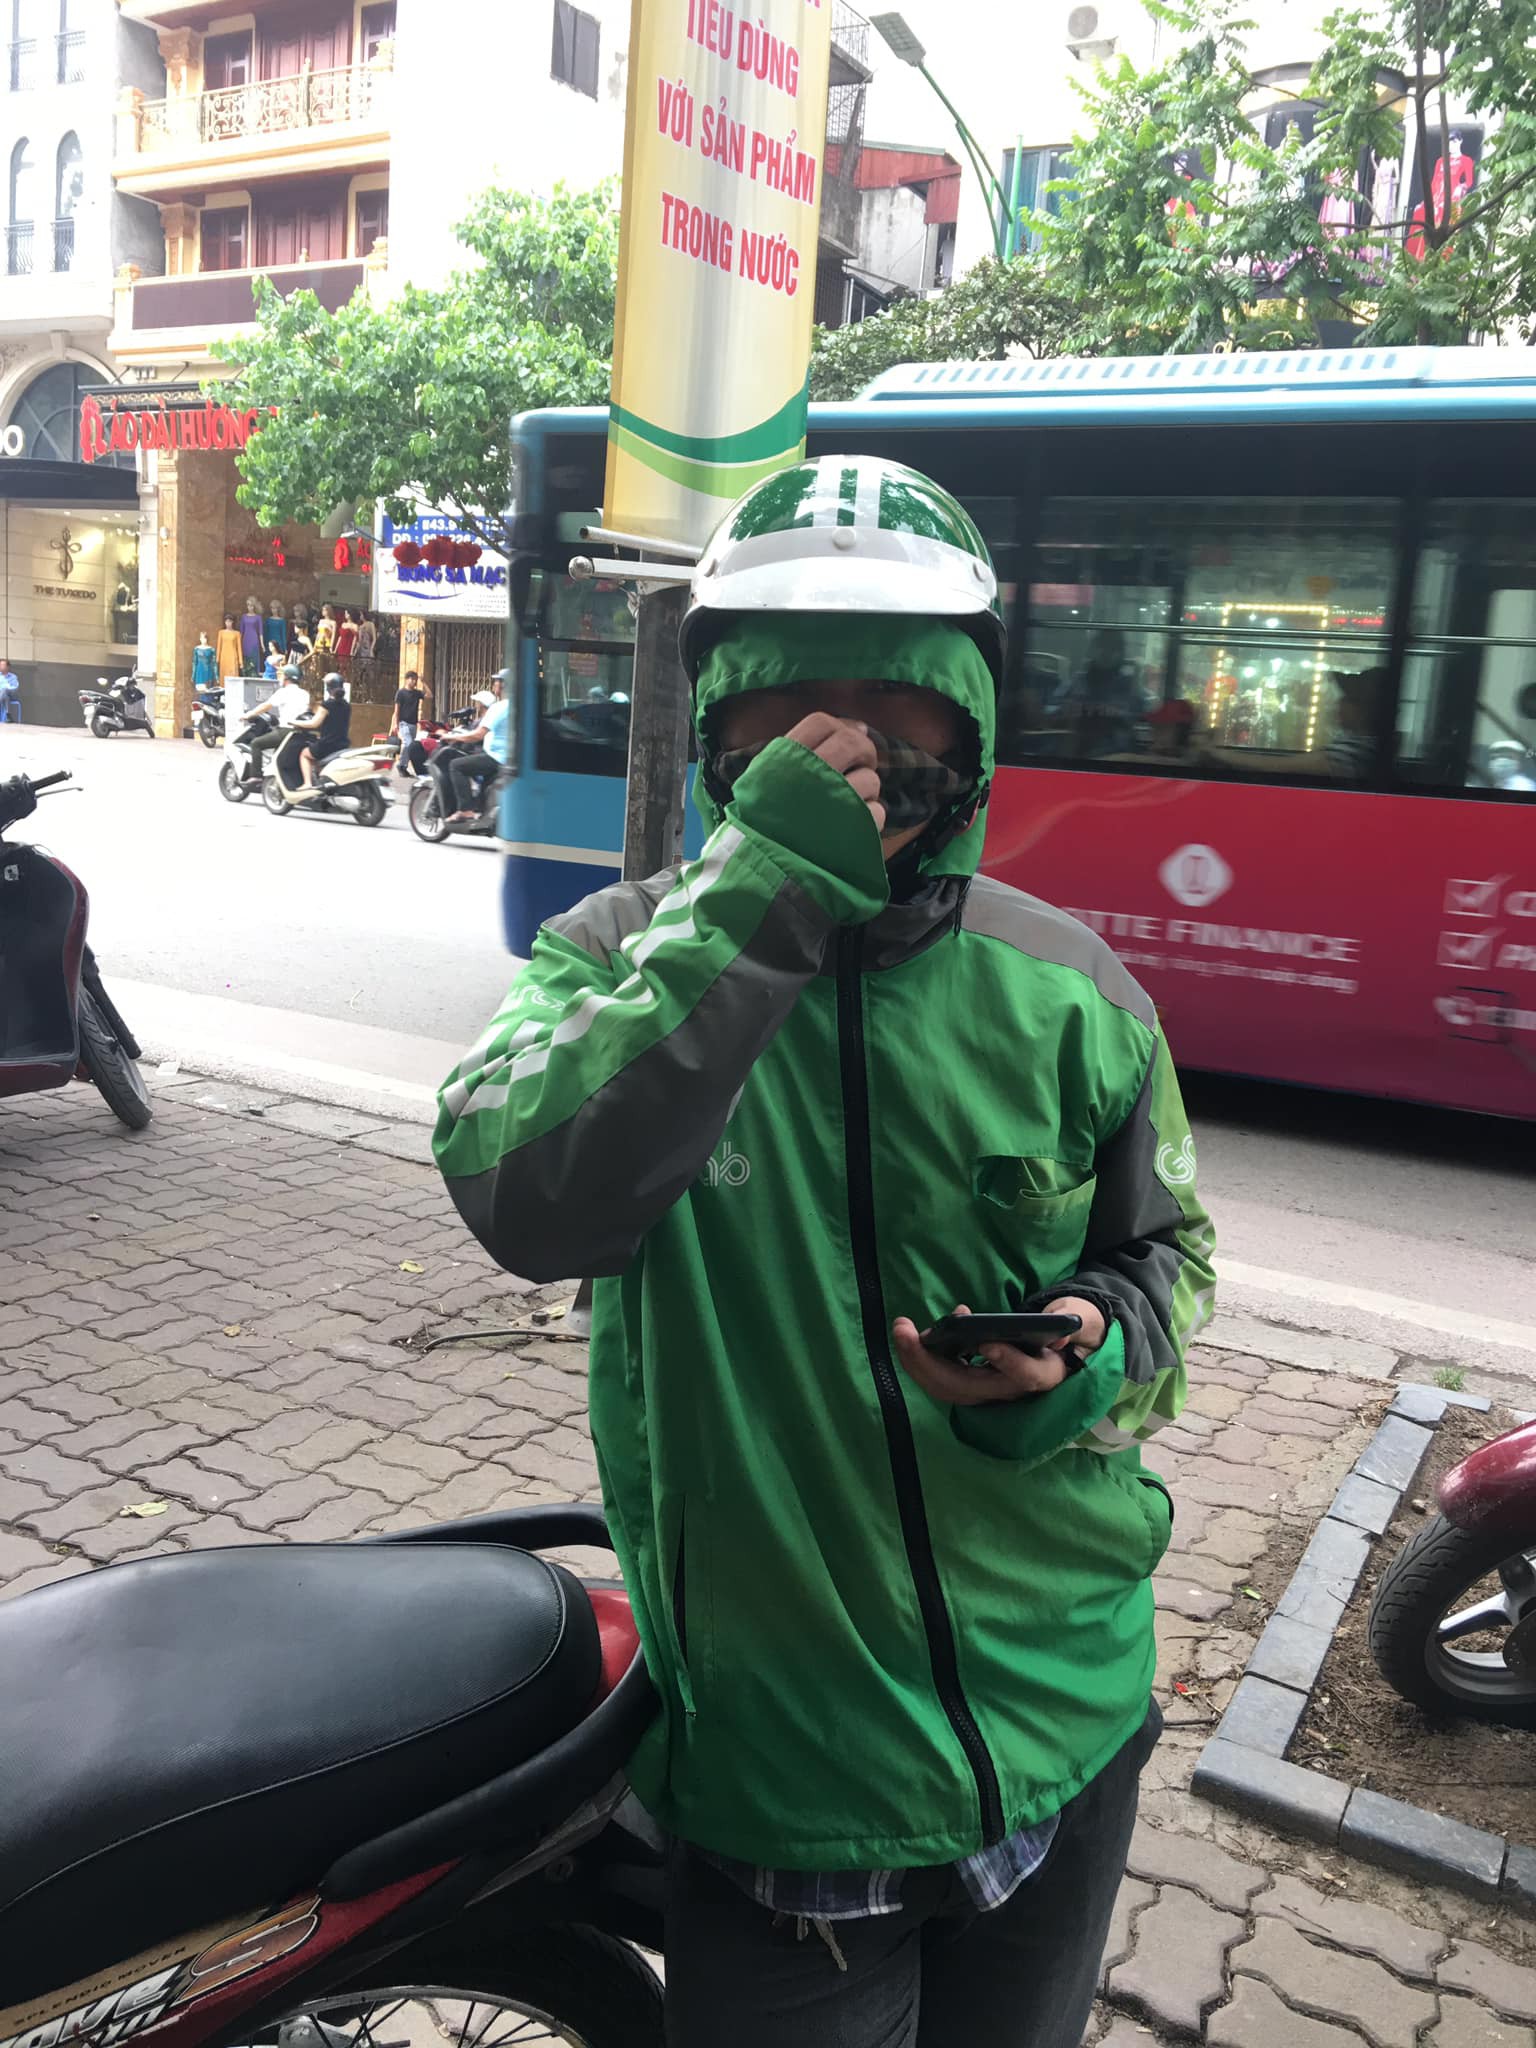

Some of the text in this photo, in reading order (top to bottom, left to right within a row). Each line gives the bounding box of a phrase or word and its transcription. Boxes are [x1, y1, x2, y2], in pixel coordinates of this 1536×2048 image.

[737, 19, 800, 97] DÙNG
[658, 78, 816, 205] VỚI SẢN PHẨM
[662, 192, 799, 296] TRONG NƯỚC
[0, 425, 24, 457] O
[140, 396, 177, 450] DÀI
[33, 584, 54, 596] THE
[1166, 919, 1361, 963] FINANCE
